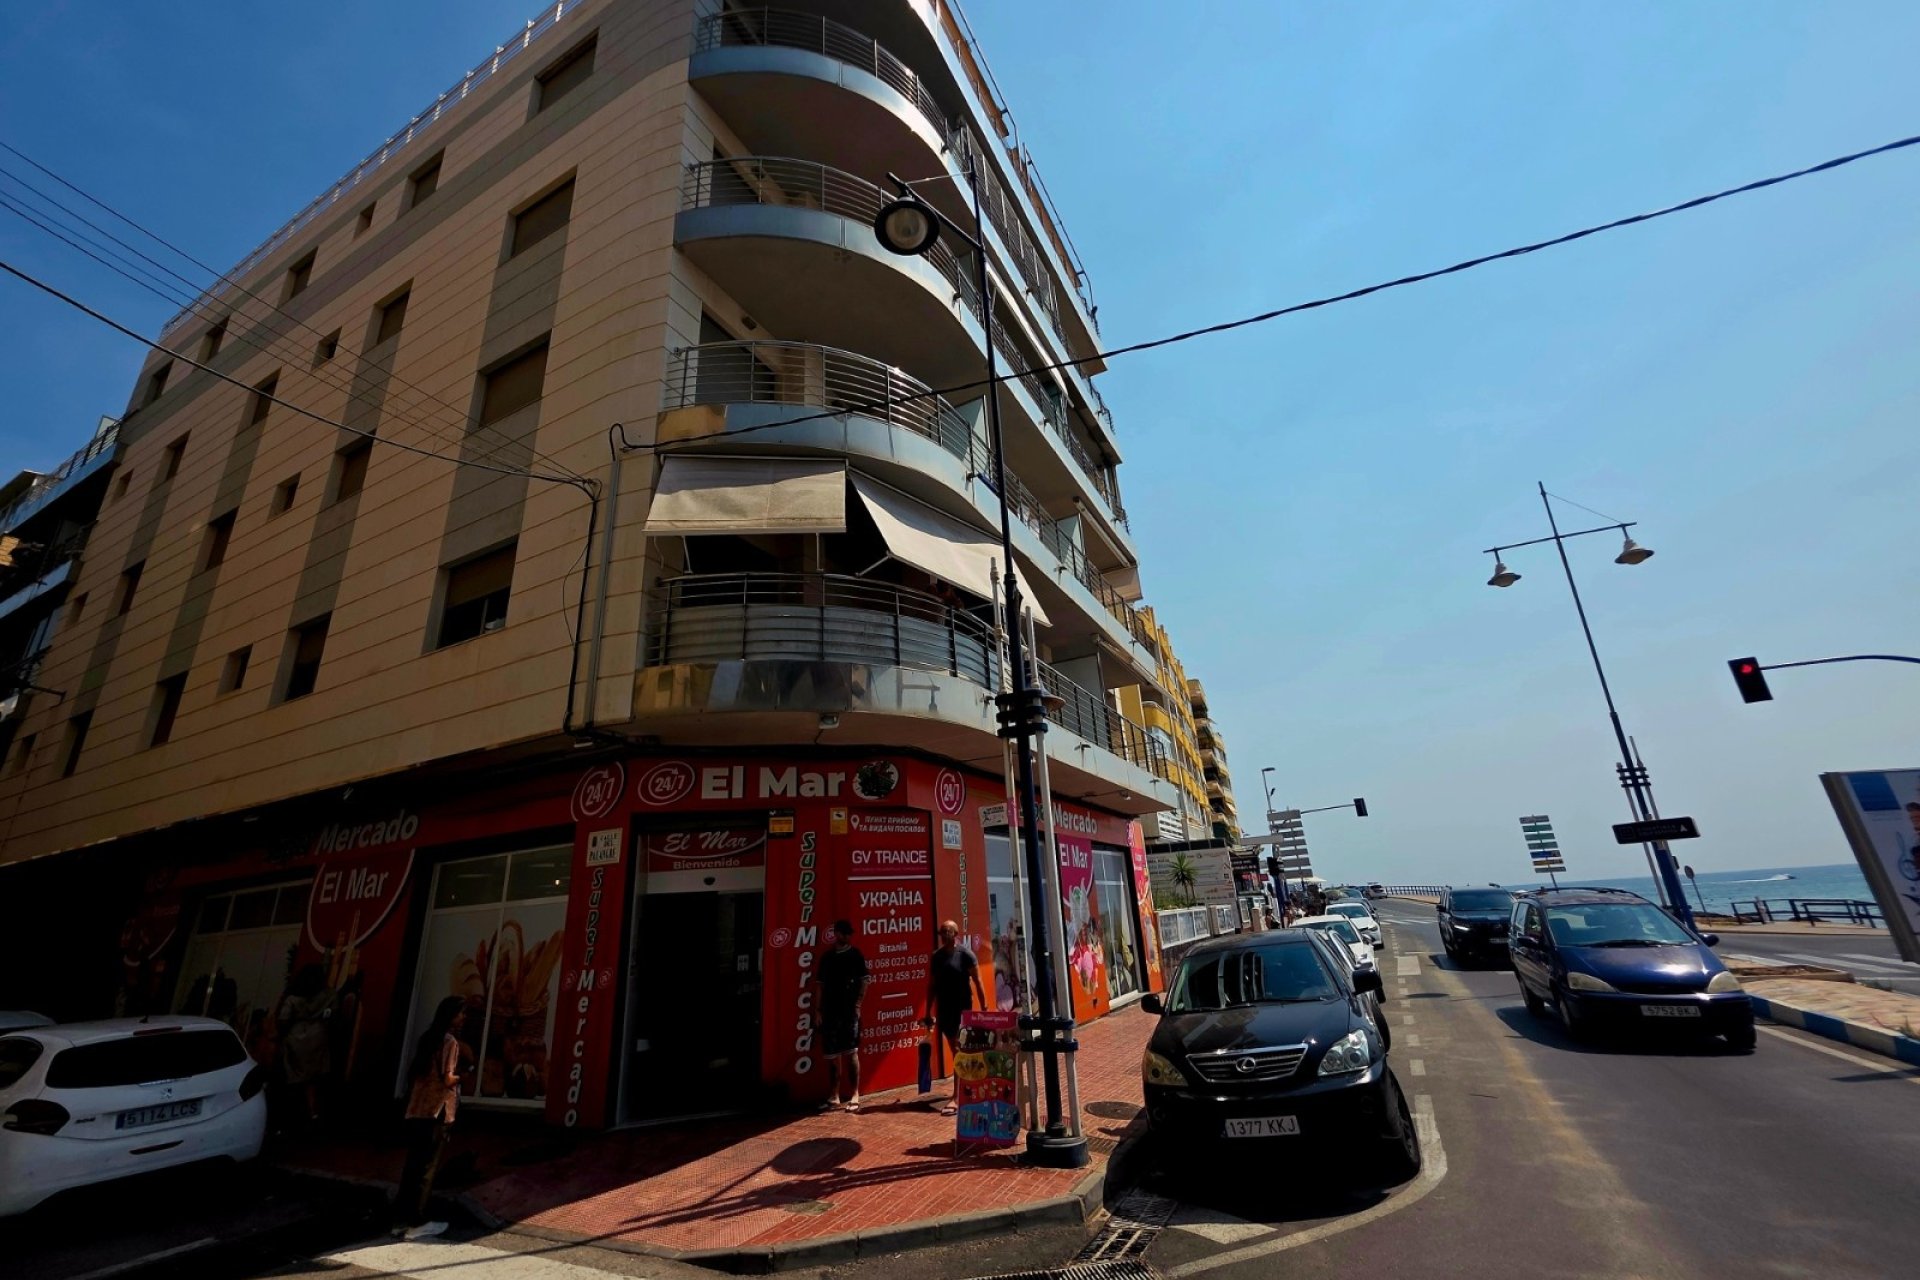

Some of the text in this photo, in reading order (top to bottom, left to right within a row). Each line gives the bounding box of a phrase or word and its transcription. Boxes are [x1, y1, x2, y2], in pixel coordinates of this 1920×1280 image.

[585, 777, 616, 808] 24/7
[654, 774, 686, 793] 24/7
[701, 765, 846, 800] El Mar
[1052, 802, 1098, 835] Mercado
[314, 808, 419, 857] Mercado
[663, 830, 750, 853] El Mar
[673, 858, 740, 870] Bienvenido
[852, 850, 928, 864] GV TRANCE
[1060, 843, 1088, 869] El Mar
[318, 867, 389, 904] El Mar
[859, 887, 924, 908] УКРАЇНА
[863, 916, 923, 936] ІСПАНІЯ
[877, 1005, 914, 1022] Григорій
[126, 1102, 198, 1124] 5114 LCS
[1229, 1117, 1296, 1136] 1377 KKJ
